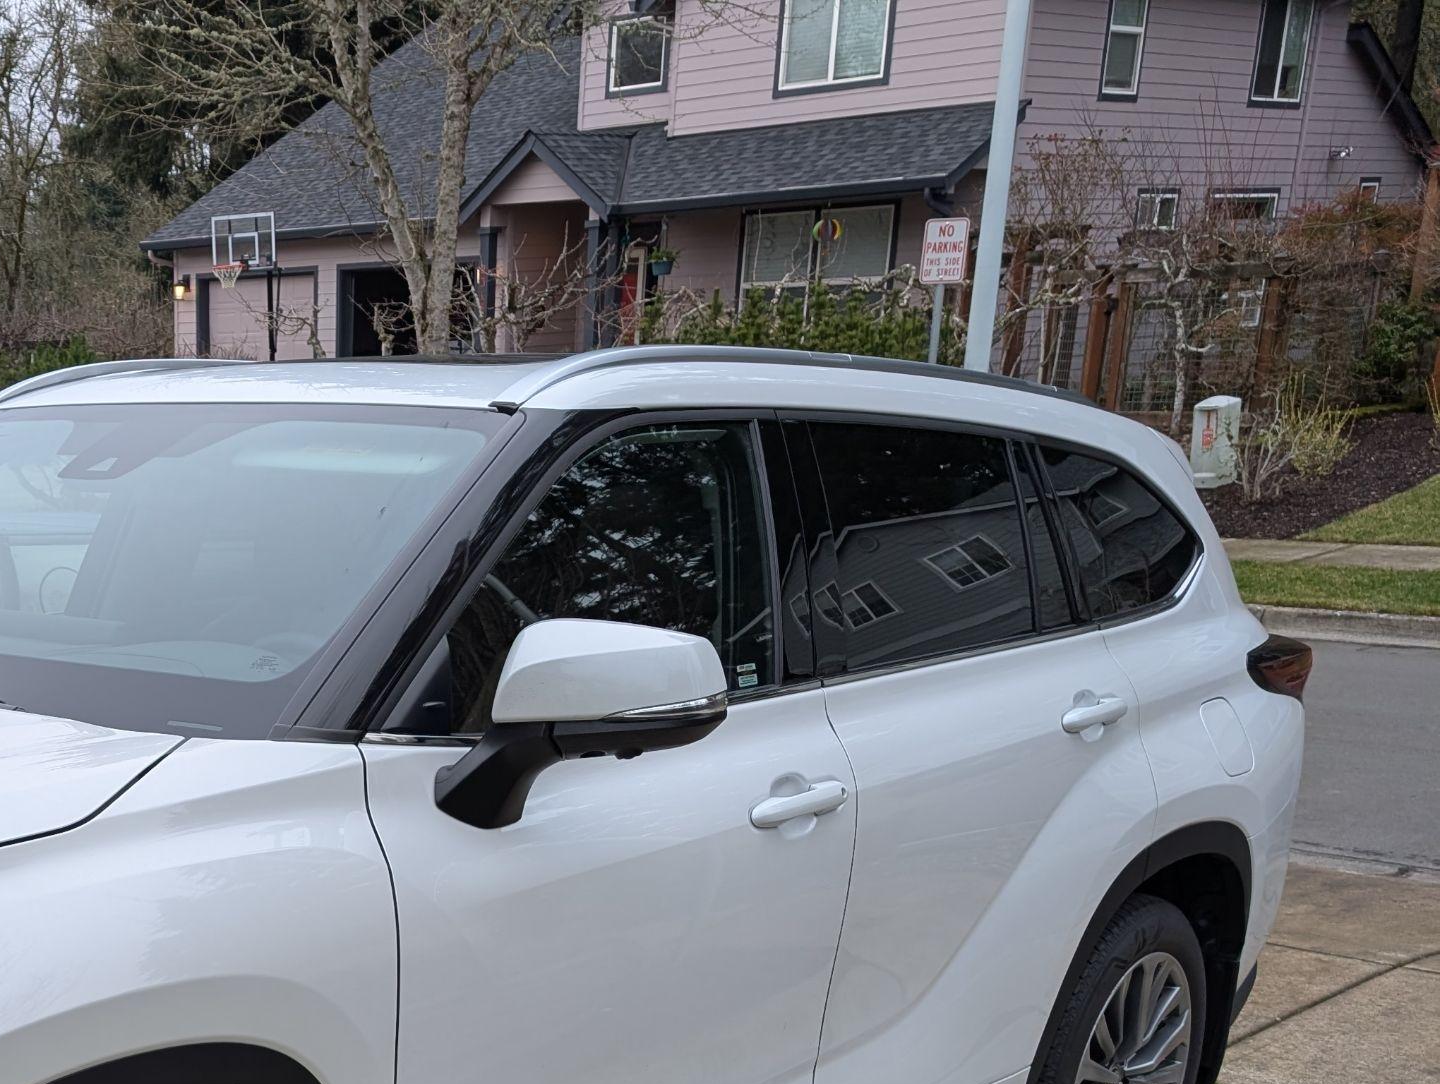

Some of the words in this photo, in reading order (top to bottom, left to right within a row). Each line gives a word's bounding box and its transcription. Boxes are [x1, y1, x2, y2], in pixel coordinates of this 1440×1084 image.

[939, 224, 954, 237] NO
[926, 241, 963, 254] PARKING
[926, 258, 941, 266] THIS
[944, 257, 961, 265] SIDE
[923, 268, 931, 276] OF
[936, 268, 959, 276] STREET
